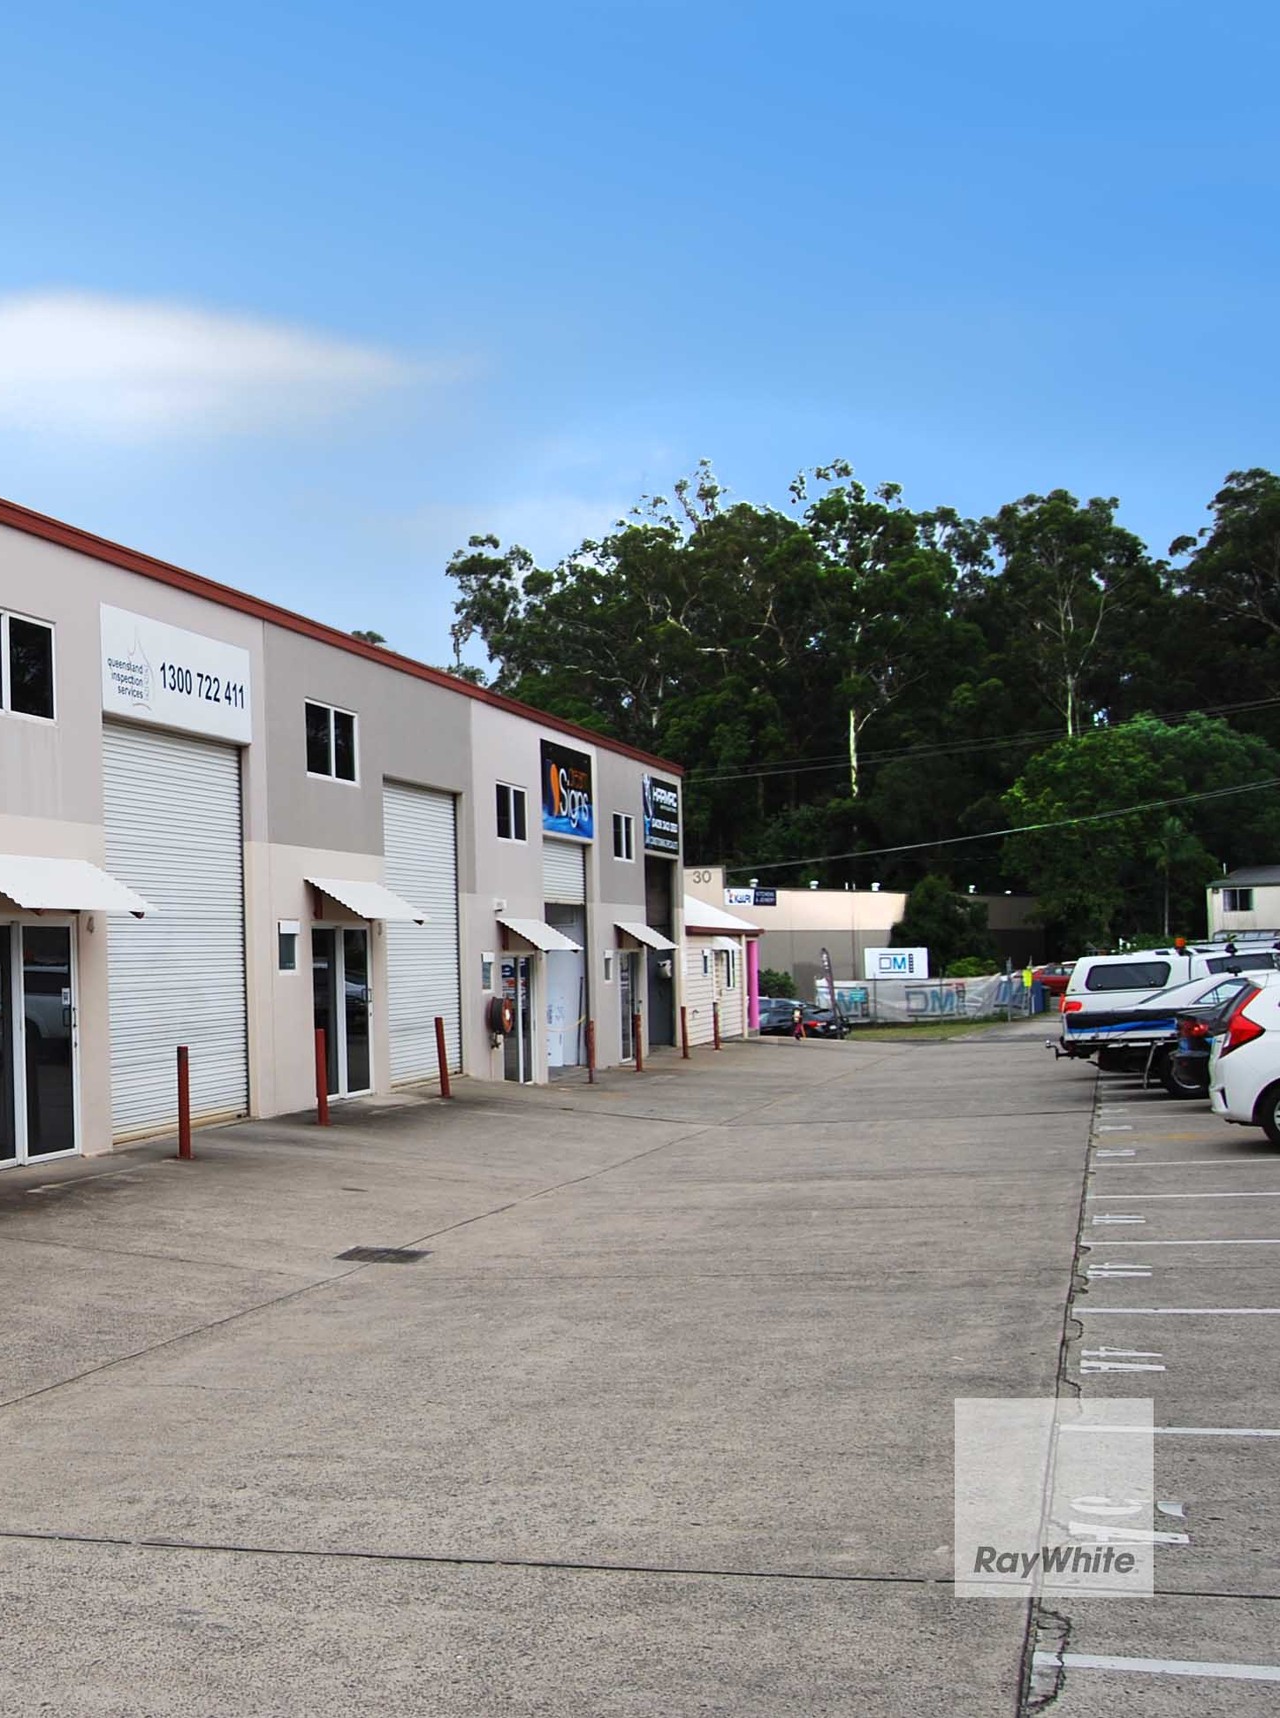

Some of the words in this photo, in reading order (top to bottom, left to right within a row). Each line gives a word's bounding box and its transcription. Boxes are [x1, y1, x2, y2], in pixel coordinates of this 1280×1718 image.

[107, 657, 144, 674] queensland
[111, 671, 144, 687] inspection
[160, 662, 193, 695] 1300
[196, 672, 221, 703] 722
[224, 680, 245, 709] 411
[117, 685, 144, 700] services
[559, 768, 589, 828] Signs
[692, 870, 712, 884] 30
